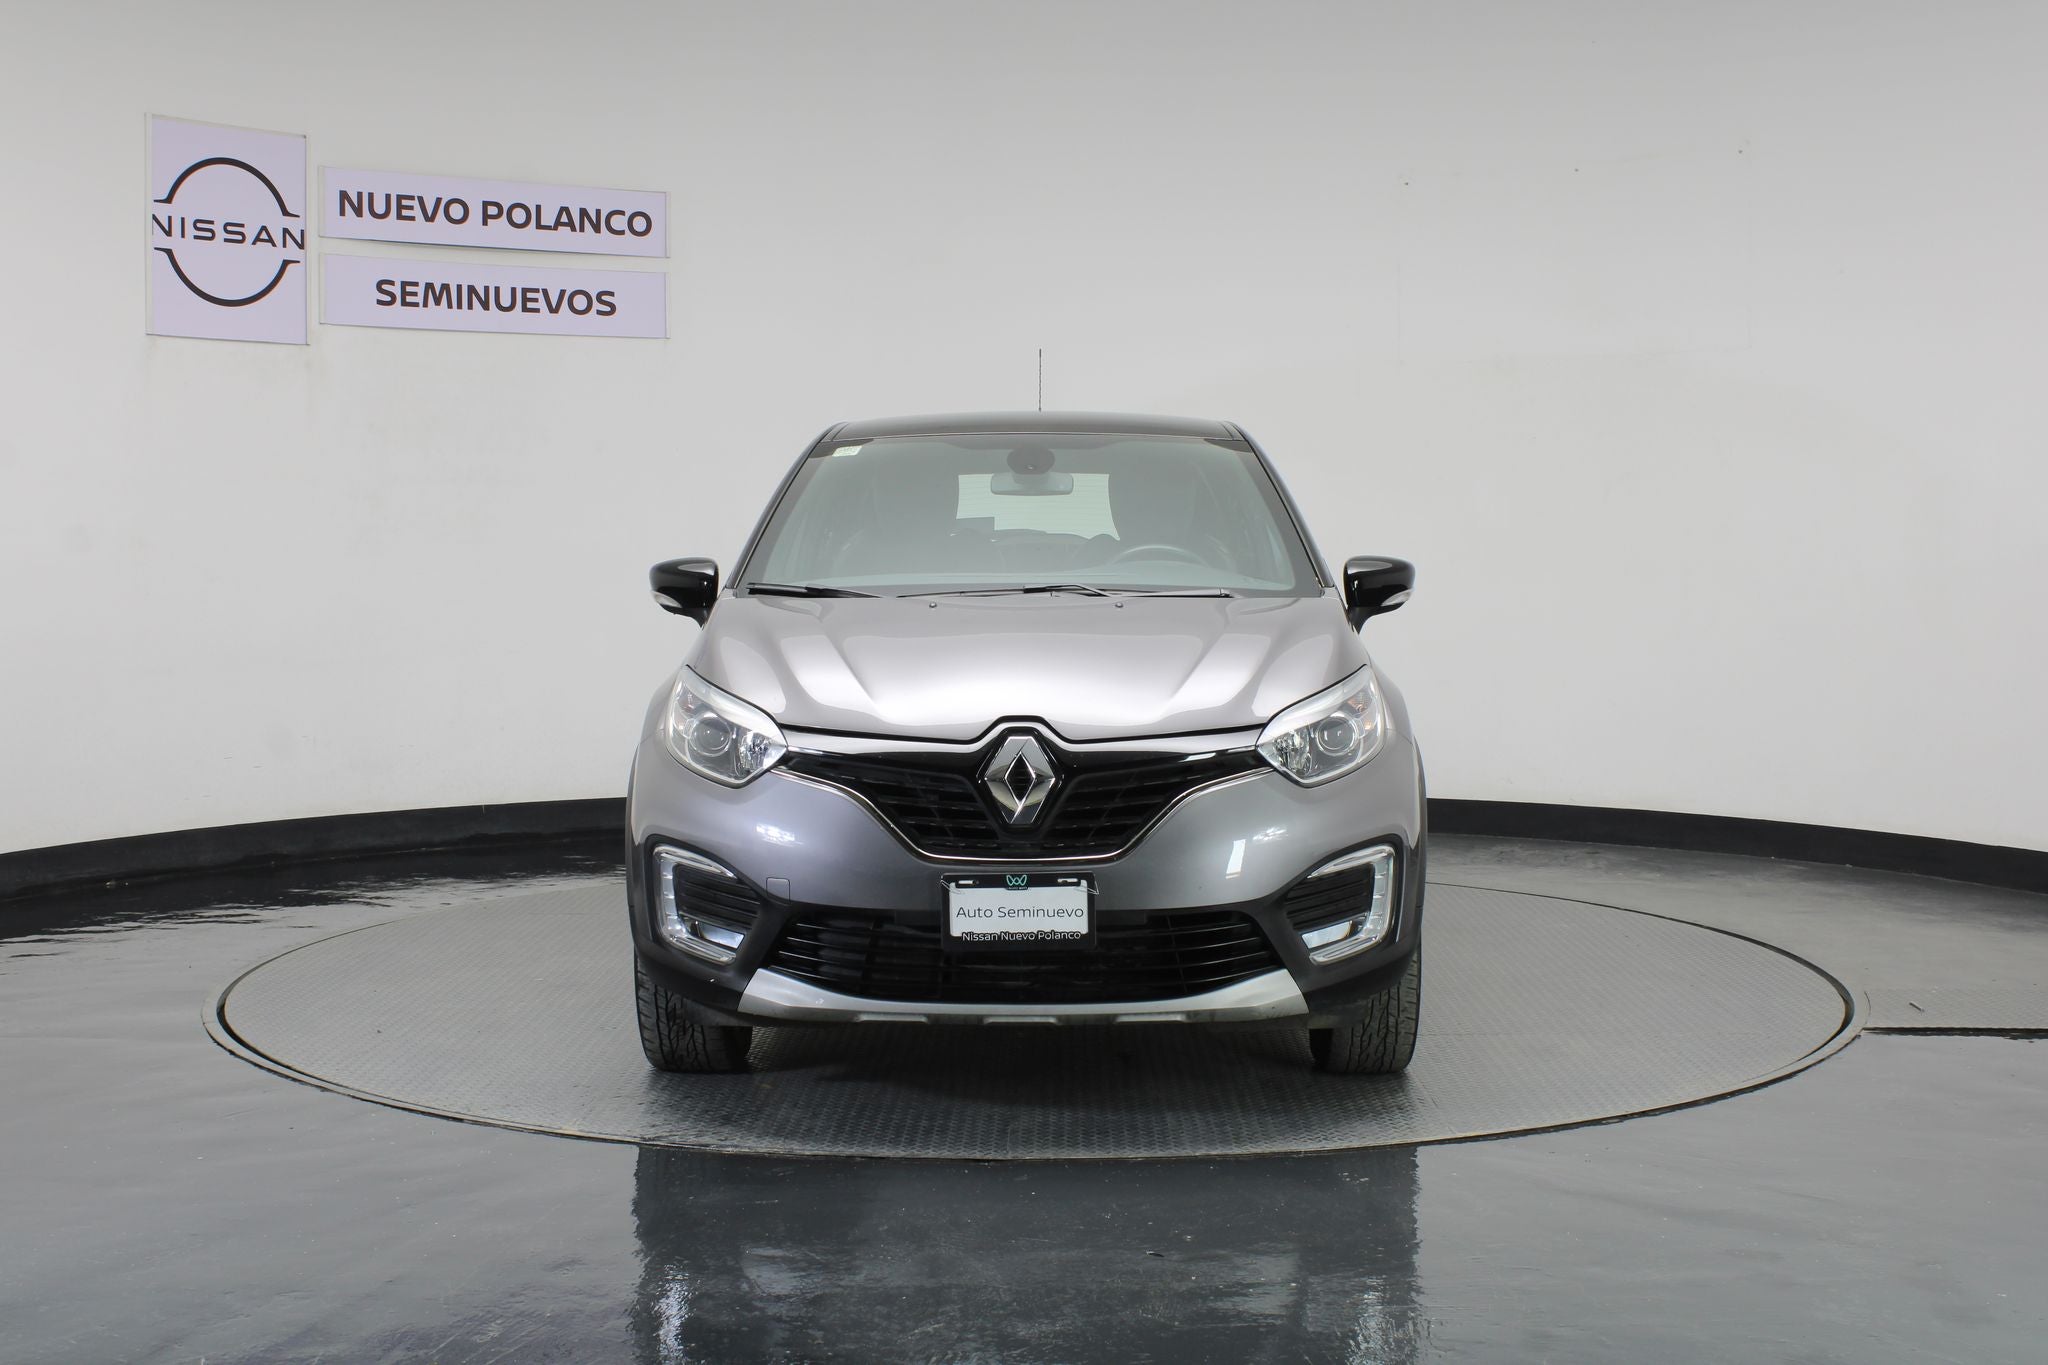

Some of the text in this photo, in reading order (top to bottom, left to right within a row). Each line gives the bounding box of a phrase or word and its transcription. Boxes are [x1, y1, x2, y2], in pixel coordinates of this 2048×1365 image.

[338, 190, 653, 237] NUEVO POLANCO
[152, 214, 305, 250] NISSAN
[375, 279, 618, 316] SEMINUEVOS
[956, 906, 1085, 918] Auto Seminuevo
[962, 930, 1082, 941] Nissan Nuevo Polanco
